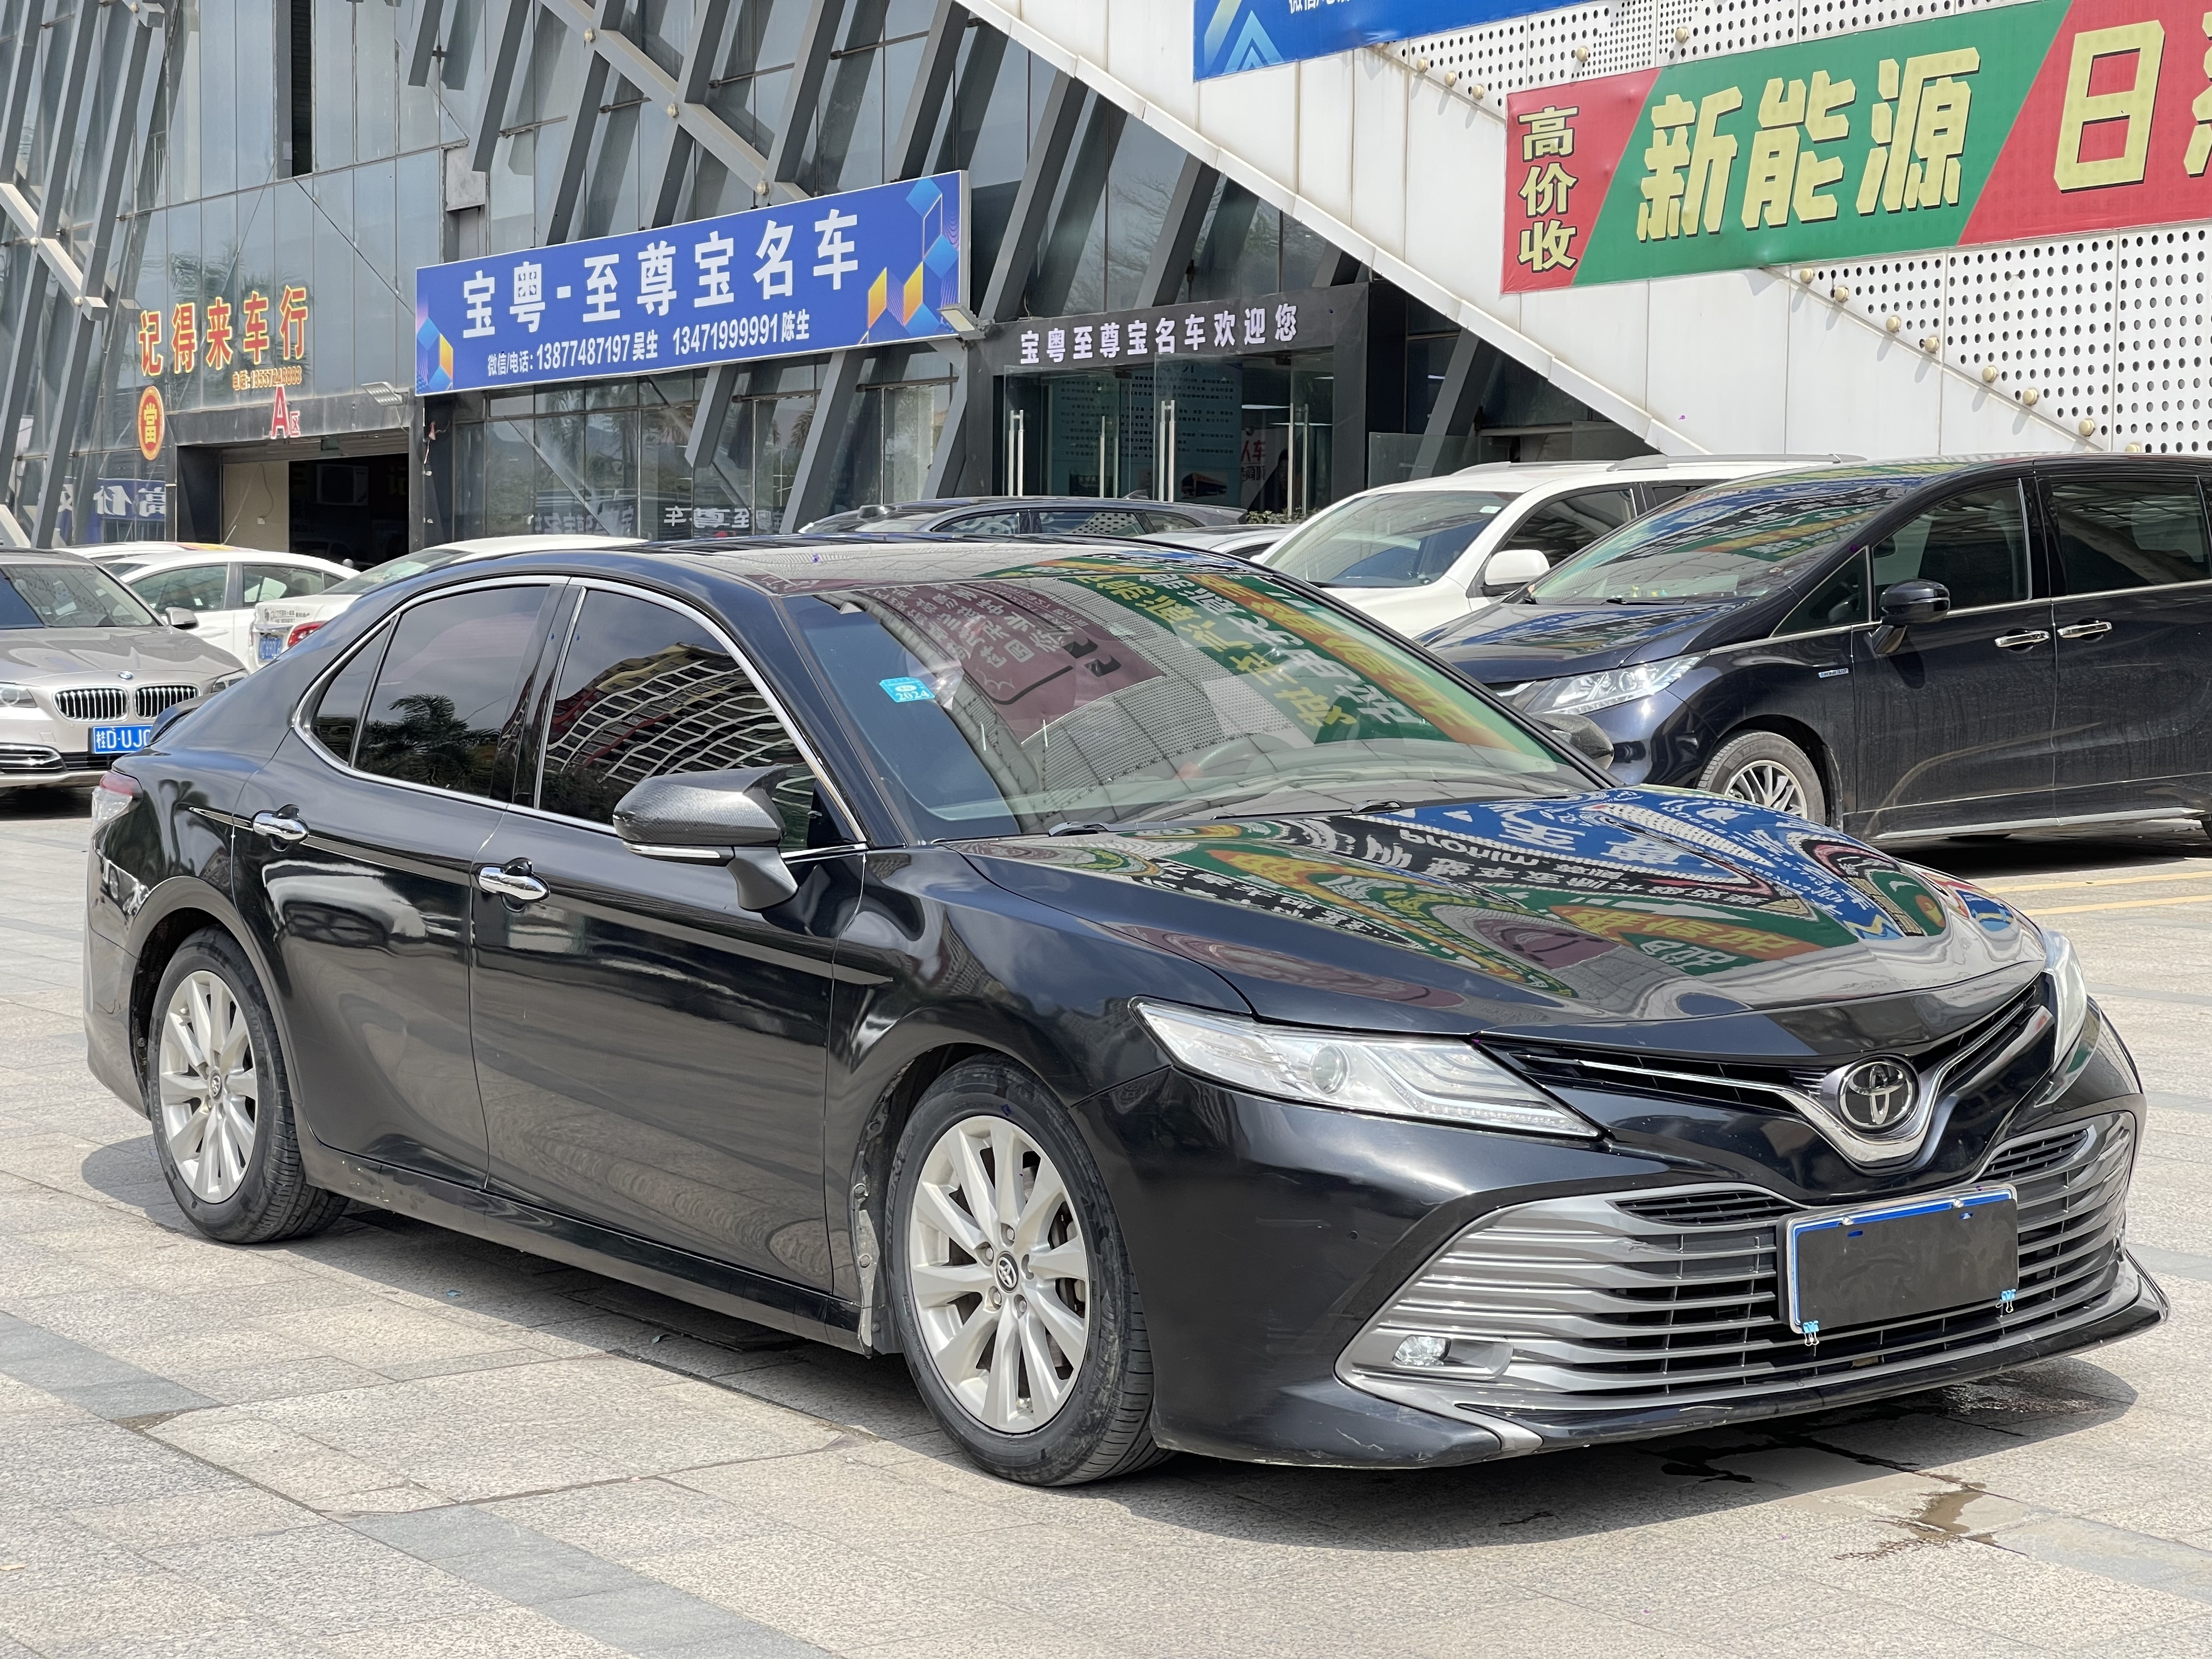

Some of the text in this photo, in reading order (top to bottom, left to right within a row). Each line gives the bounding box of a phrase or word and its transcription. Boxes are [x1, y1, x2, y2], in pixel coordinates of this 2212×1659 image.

[1517, 105, 1580, 273] 高价收
[1637, 47, 1980, 242] 新能源
[138, 285, 308, 377] 记得来车行
[1020, 303, 1298, 364] 宝粤至尊宝名车欢迎您
[896, 690, 930, 701] 2024
